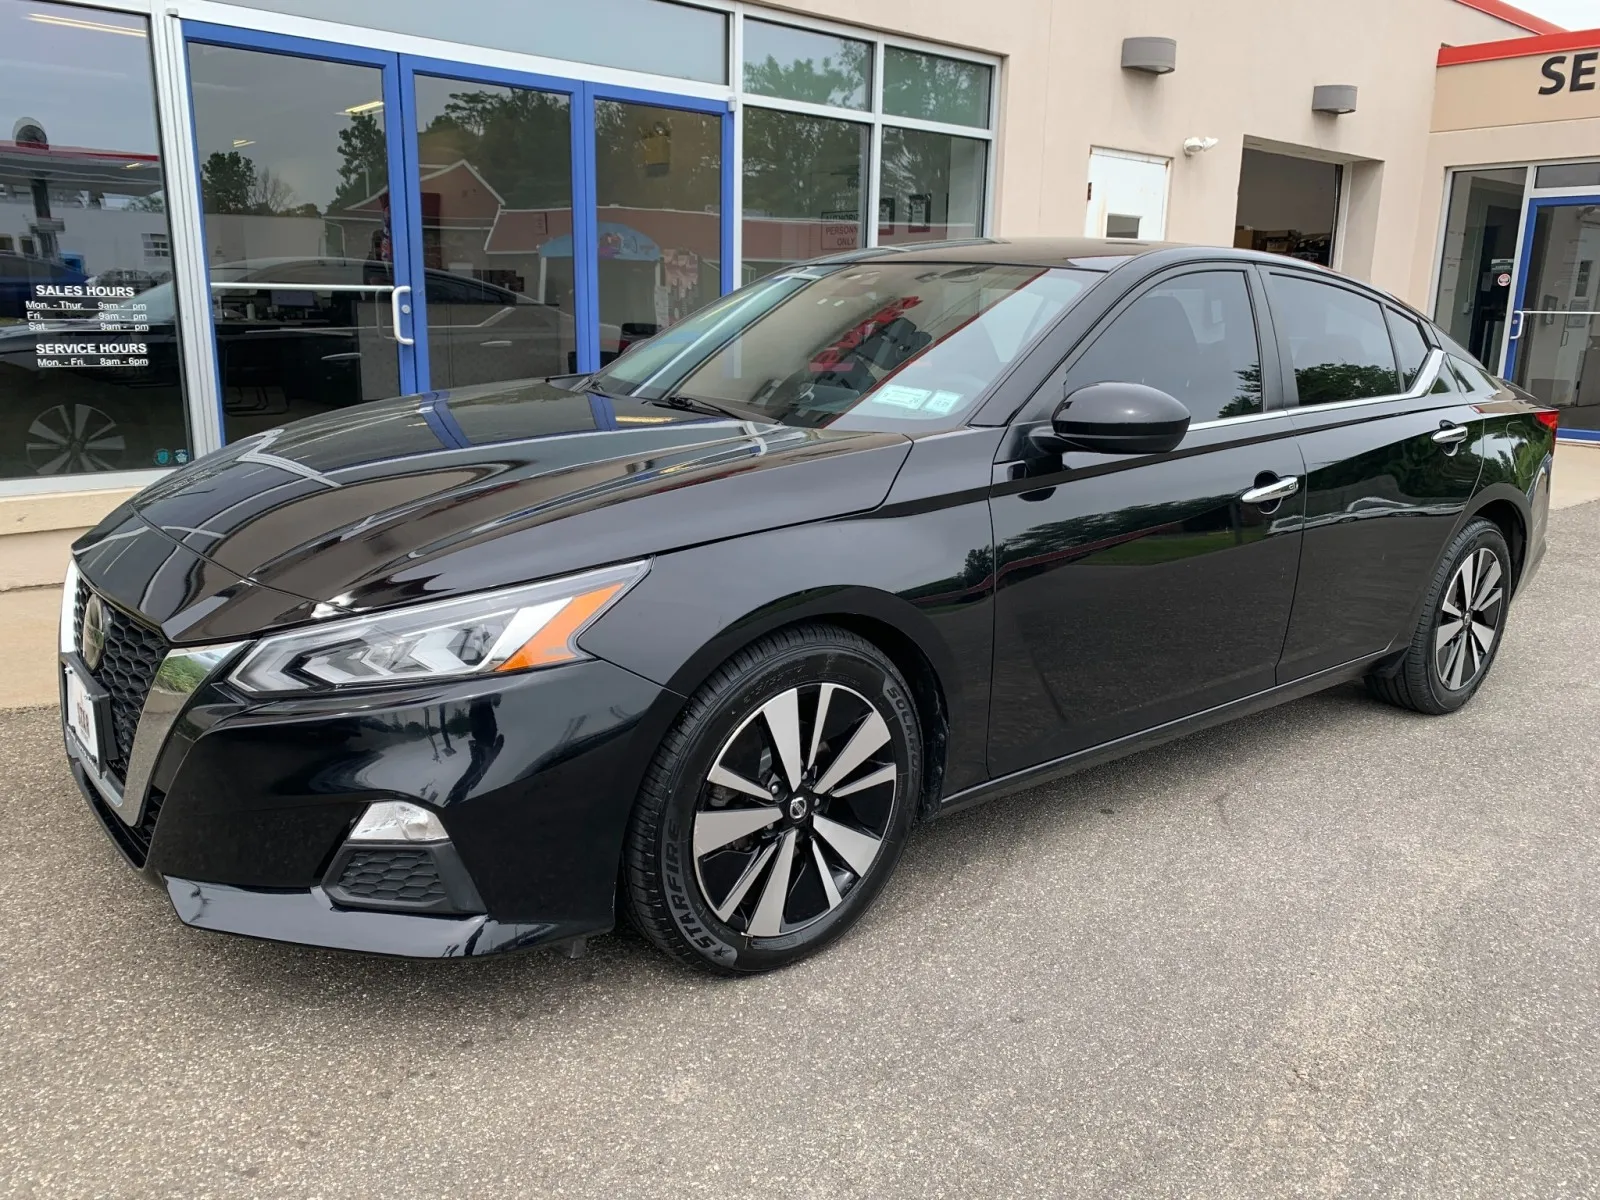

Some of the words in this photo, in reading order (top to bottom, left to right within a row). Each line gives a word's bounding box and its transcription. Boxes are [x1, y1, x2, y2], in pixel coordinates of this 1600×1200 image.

[836, 237, 855, 246] ONLY
[36, 285, 83, 297] SALES
[86, 286, 135, 297] HOURS
[25, 300, 50, 310] Mon.
[59, 300, 84, 310] Thur.
[97, 301, 119, 310] 9am
[27, 311, 43, 320] Fri.
[98, 312, 120, 320] 9am
[28, 322, 48, 331] Sat.
[100, 322, 121, 331] 9am
[36, 343, 96, 354] SERVICE
[99, 343, 148, 354] HOURS
[37, 358, 62, 367] Mon.
[70, 357, 87, 367] Fri.
[99, 357, 121, 366] 8am
[128, 357, 149, 367] 6pm
[666, 818, 717, 949] STARFIRE
